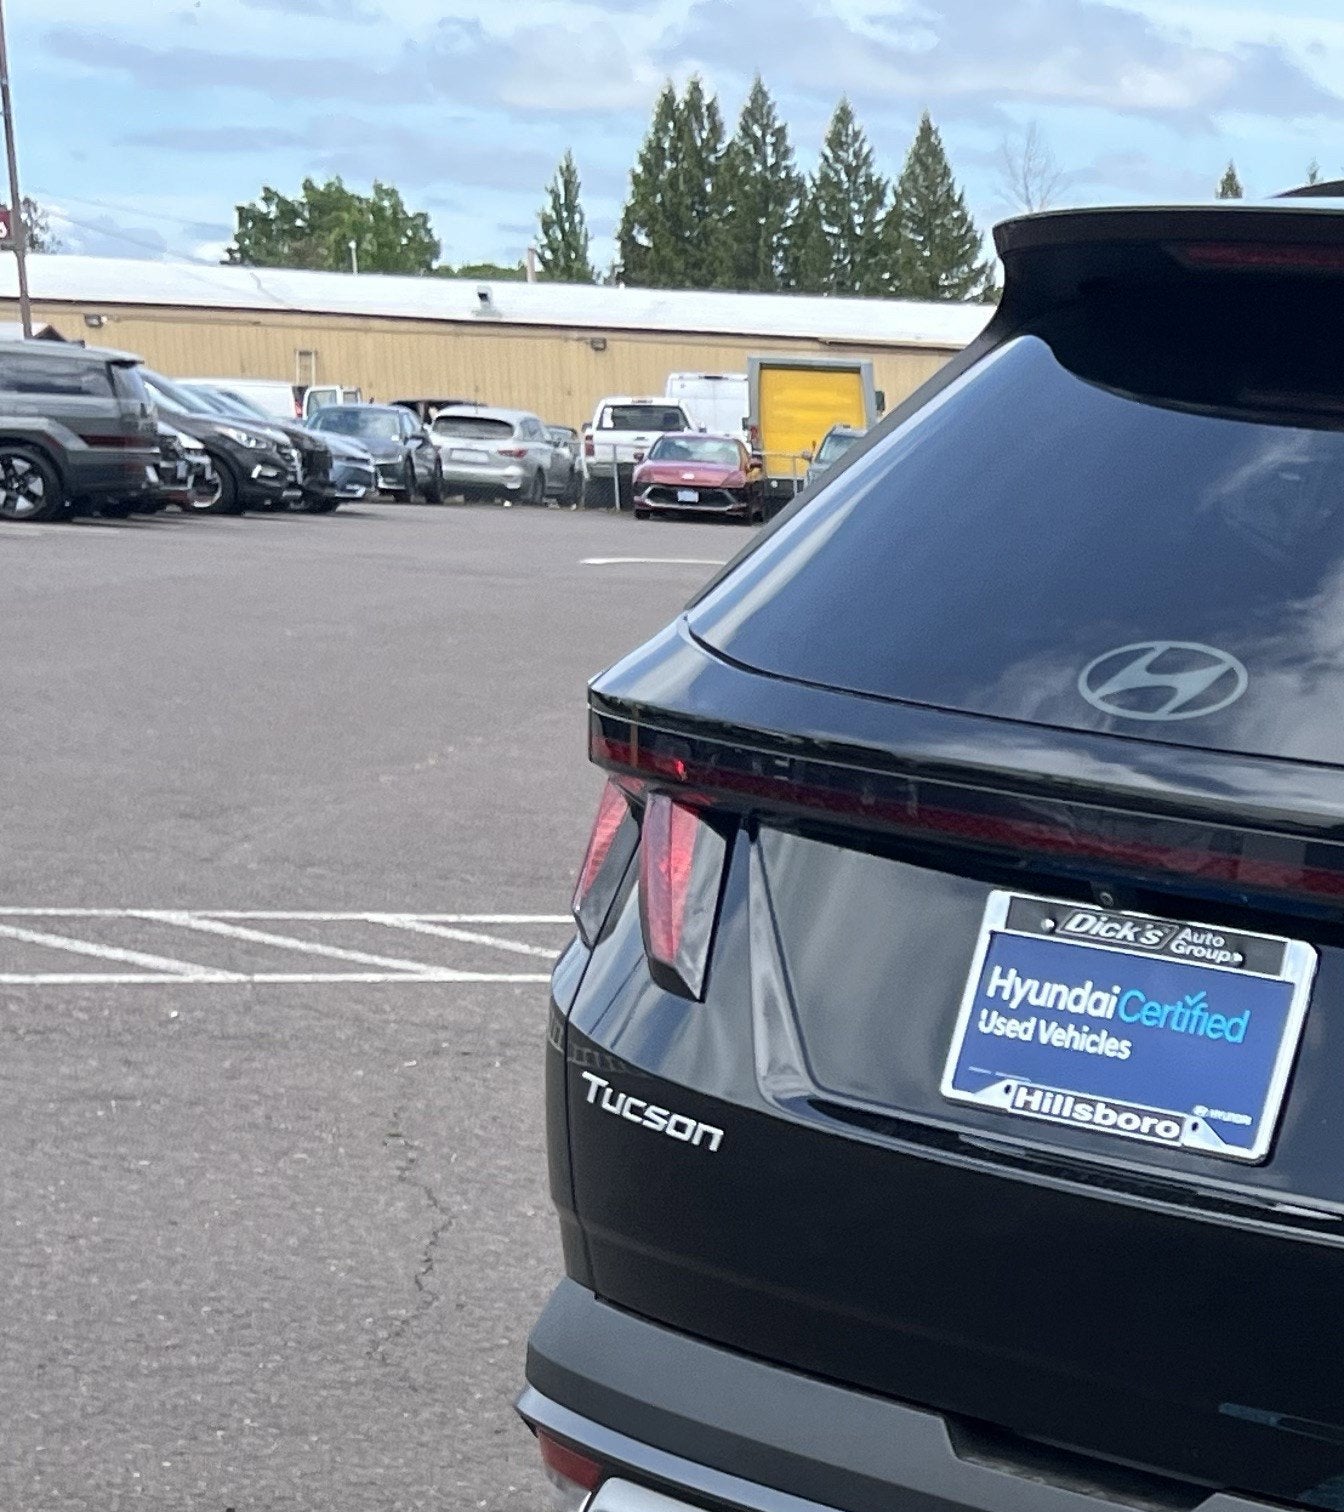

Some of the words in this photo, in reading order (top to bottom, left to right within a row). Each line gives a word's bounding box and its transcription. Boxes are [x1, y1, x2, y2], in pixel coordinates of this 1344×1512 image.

[1065, 913, 1164, 946] Dick's
[1177, 928, 1226, 948] Auto
[1170, 940, 1233, 964] Group
[978, 1008, 1037, 1042] Used
[1038, 1018, 1133, 1061] Vehicles
[581, 1070, 725, 1152] Tucson
[1012, 1085, 1181, 1140] Hillsboro
